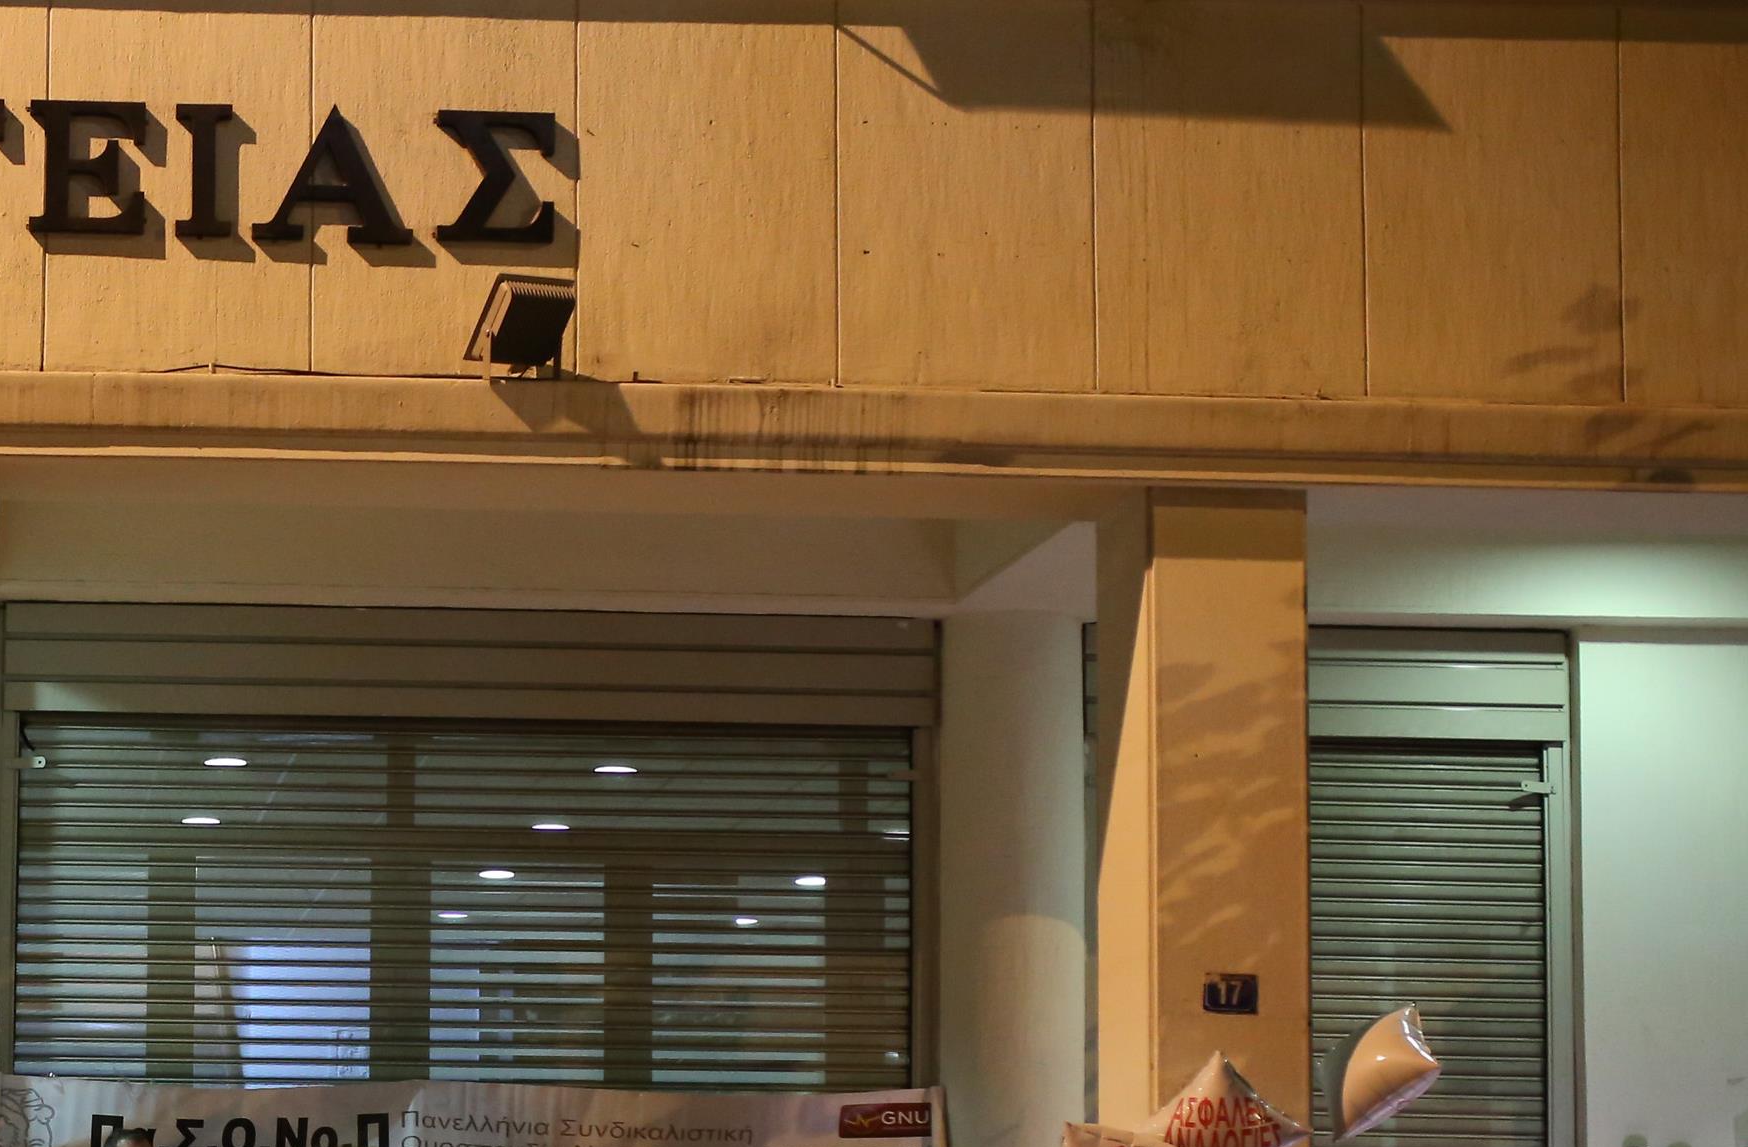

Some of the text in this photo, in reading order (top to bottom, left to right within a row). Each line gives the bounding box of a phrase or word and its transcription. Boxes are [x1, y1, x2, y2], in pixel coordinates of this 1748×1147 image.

[1217, 981, 1243, 1005] 17
[402, 1111, 752, 1145] Πανελλήνια Συνδικαλιστική
